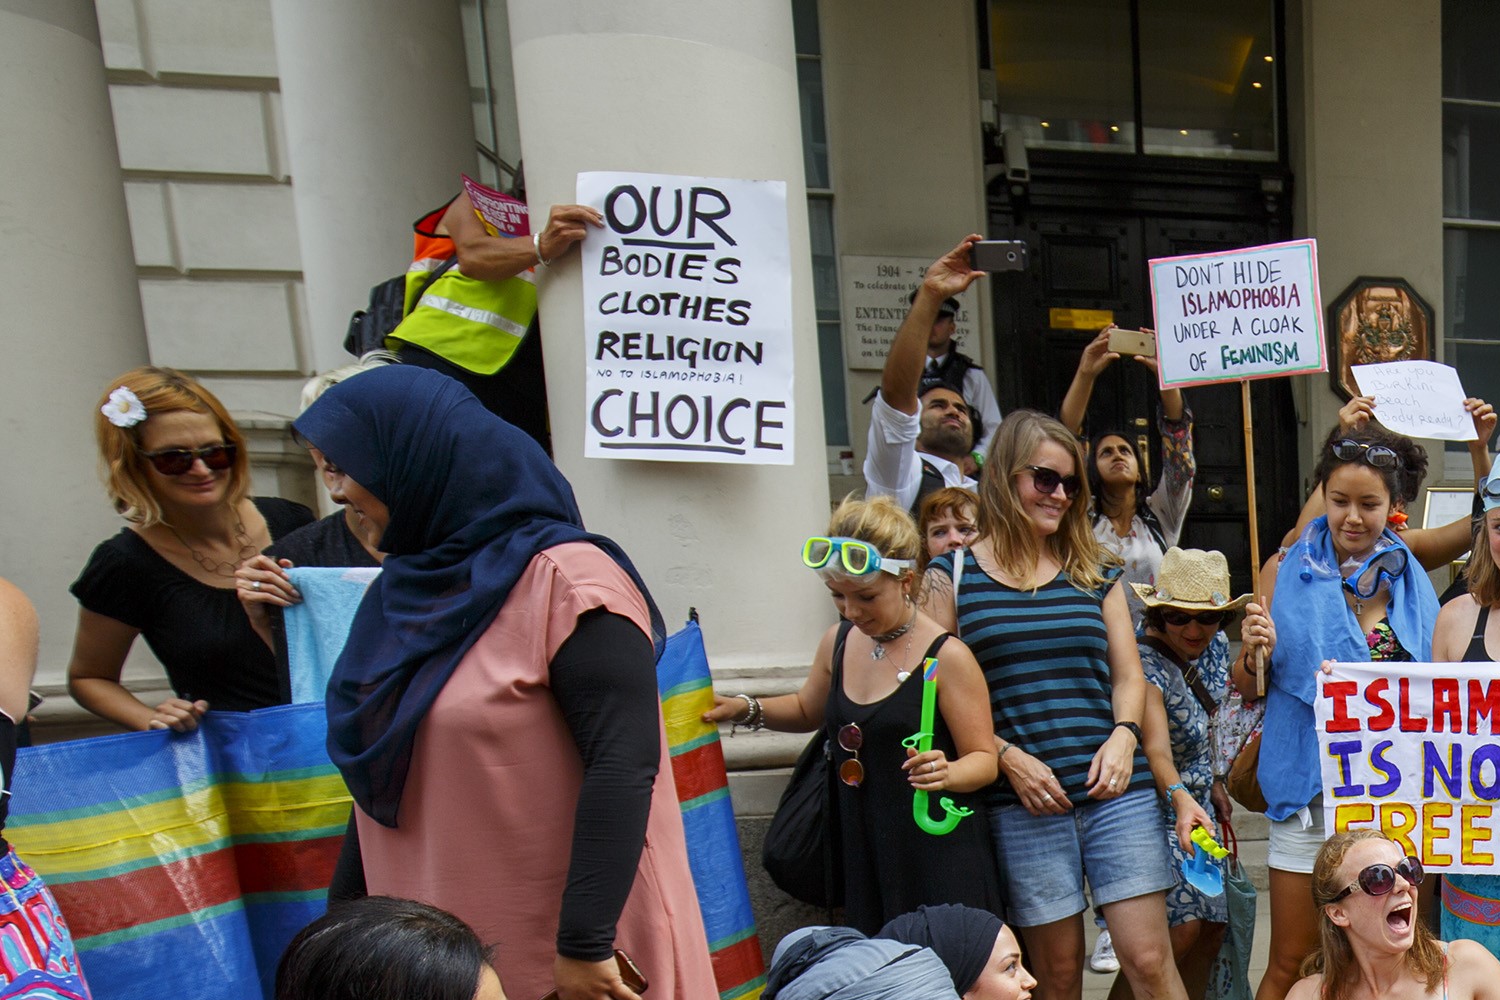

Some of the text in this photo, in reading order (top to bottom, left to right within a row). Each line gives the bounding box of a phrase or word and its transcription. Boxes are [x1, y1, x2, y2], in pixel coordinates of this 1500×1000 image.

[604, 185, 737, 246] OUR
[600, 246, 741, 284] BODIES
[876, 265, 900, 278] 1904
[1175, 259, 1282, 288] DON'T HIDE
[853, 281, 865, 289] To
[867, 281, 906, 290] celebrate
[1181, 283, 1301, 317] ISLAMOPHOBIA
[599, 291, 752, 326] CLOTHES
[855, 307, 910, 320] ENTENTE
[856, 323, 898, 332] The Franc
[1174, 314, 1304, 343] UNDER A CLOAK
[595, 330, 763, 369] RELIGION
[1189, 351, 1207, 372] OF
[596, 369, 612, 378] NO
[620, 369, 633, 379] TO
[591, 388, 786, 450] CHOICE
[1328, 739, 1403, 798] IS
